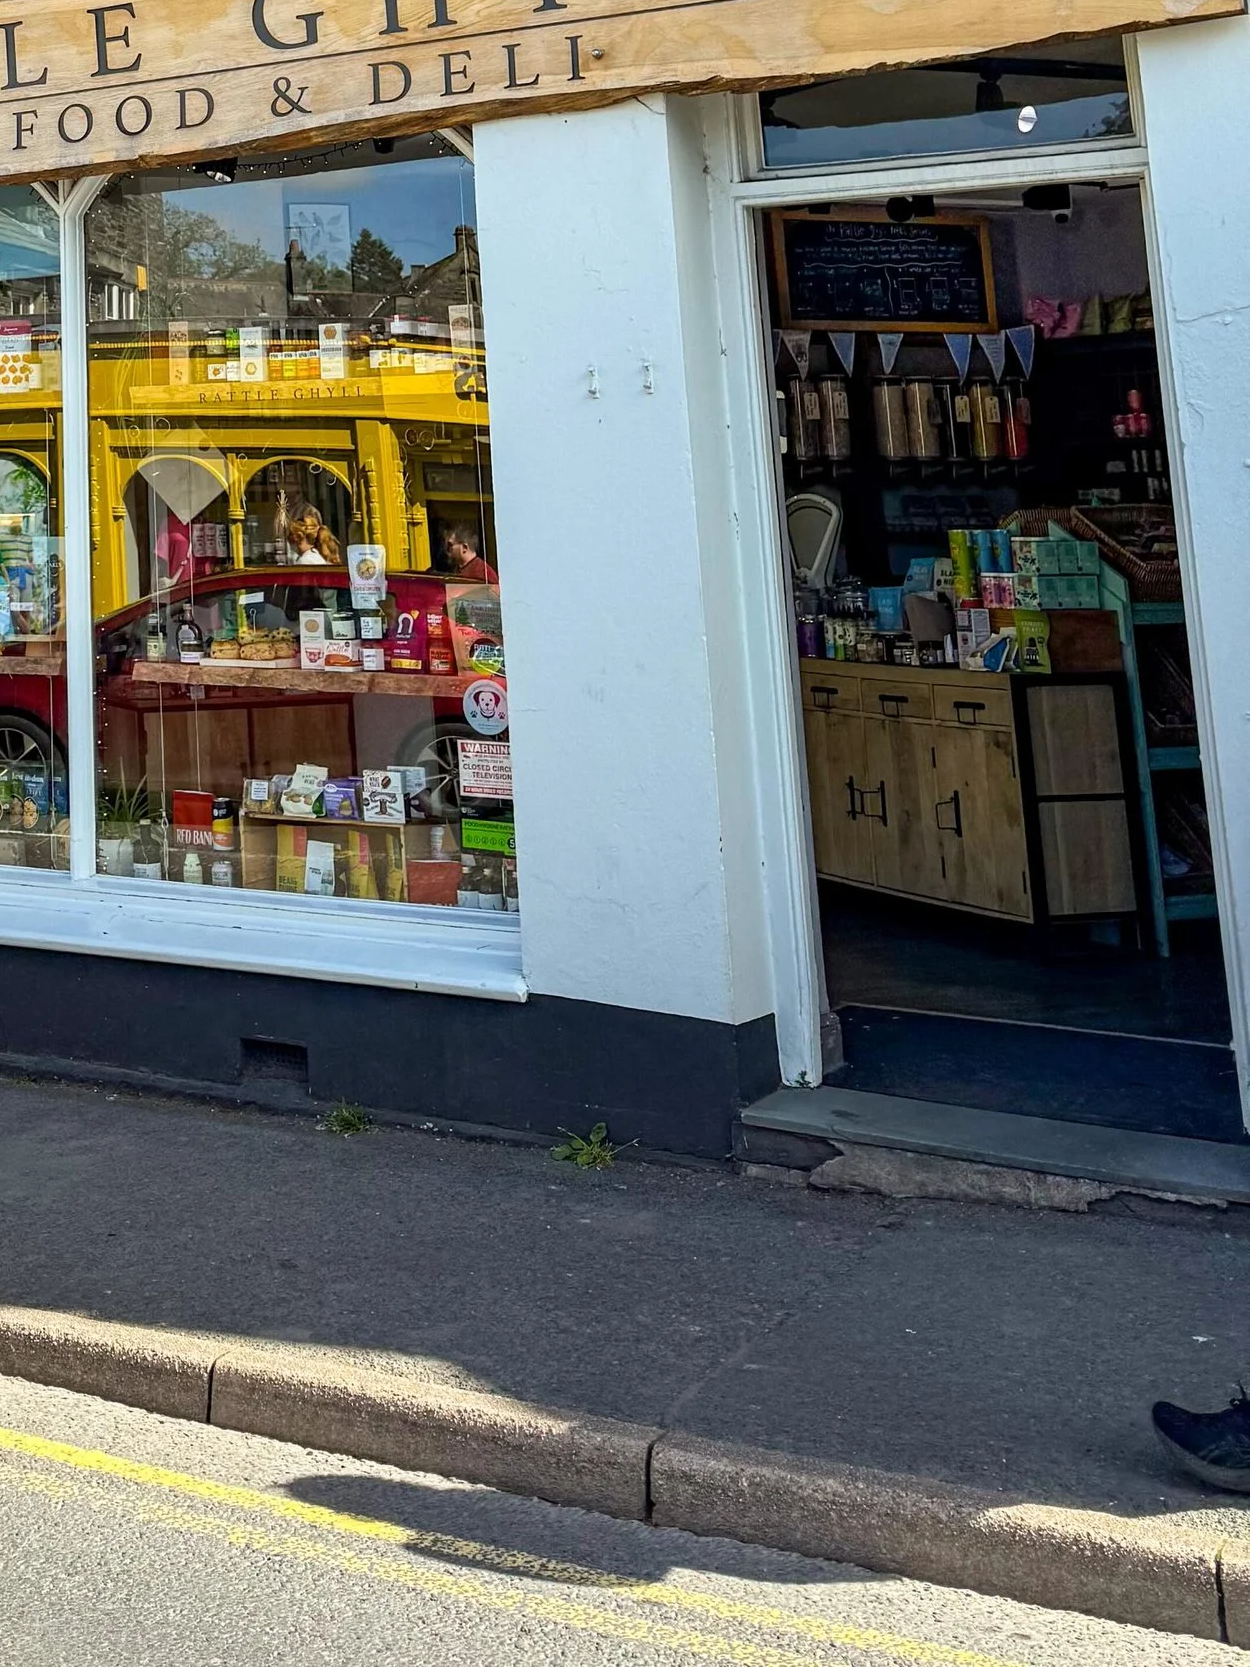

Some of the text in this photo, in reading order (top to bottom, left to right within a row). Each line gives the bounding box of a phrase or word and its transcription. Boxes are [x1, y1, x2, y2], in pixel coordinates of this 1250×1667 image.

[12, 86, 216, 151] FOOD
[269, 74, 313, 118] &
[369, 34, 588, 108] DELI
[199, 385, 366, 404] RATTLE GHYLL
[464, 743, 511, 755] WARNIN
[463, 763, 491, 772] CLOSED
[472, 772, 513, 781] TELEVISION
[176, 828, 191, 844] RED
